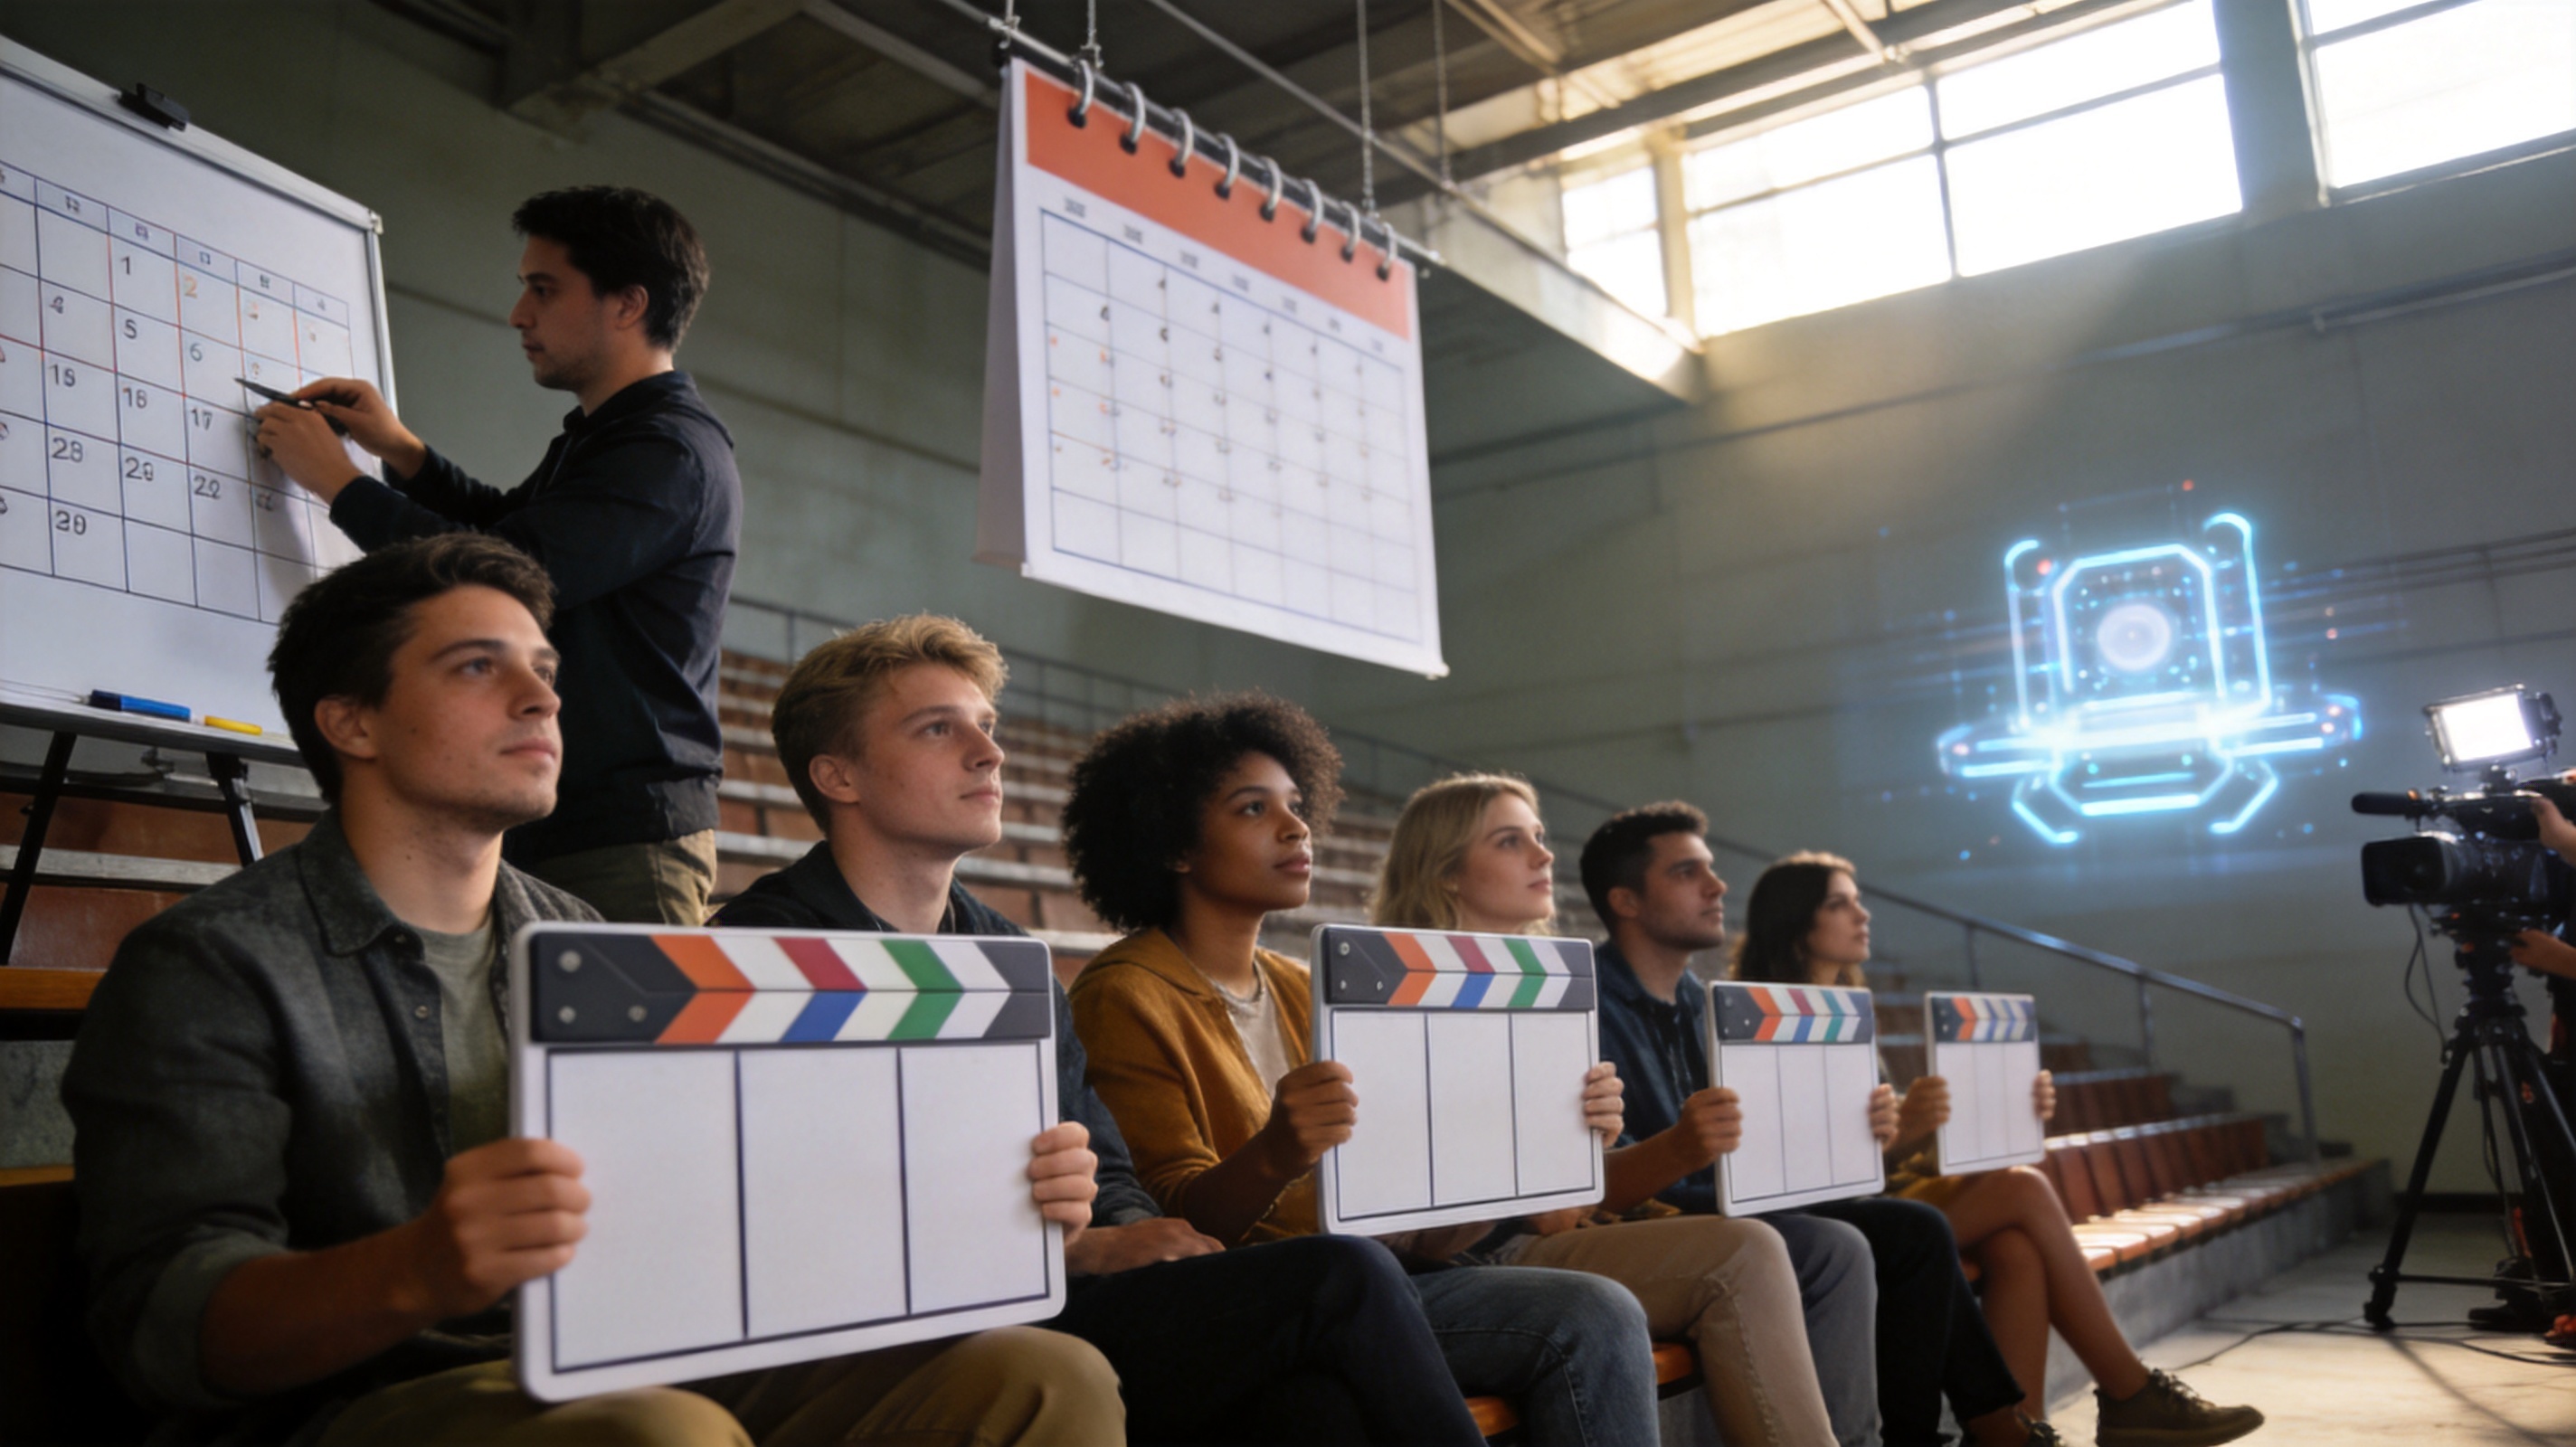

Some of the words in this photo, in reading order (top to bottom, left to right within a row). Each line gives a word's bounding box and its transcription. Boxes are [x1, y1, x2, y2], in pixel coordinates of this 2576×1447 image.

[120, 256, 131, 275] 1
[184, 275, 198, 298] 2
[123, 318, 137, 340] 5
[189, 342, 203, 362] 6
[191, 408, 213, 430] 17
